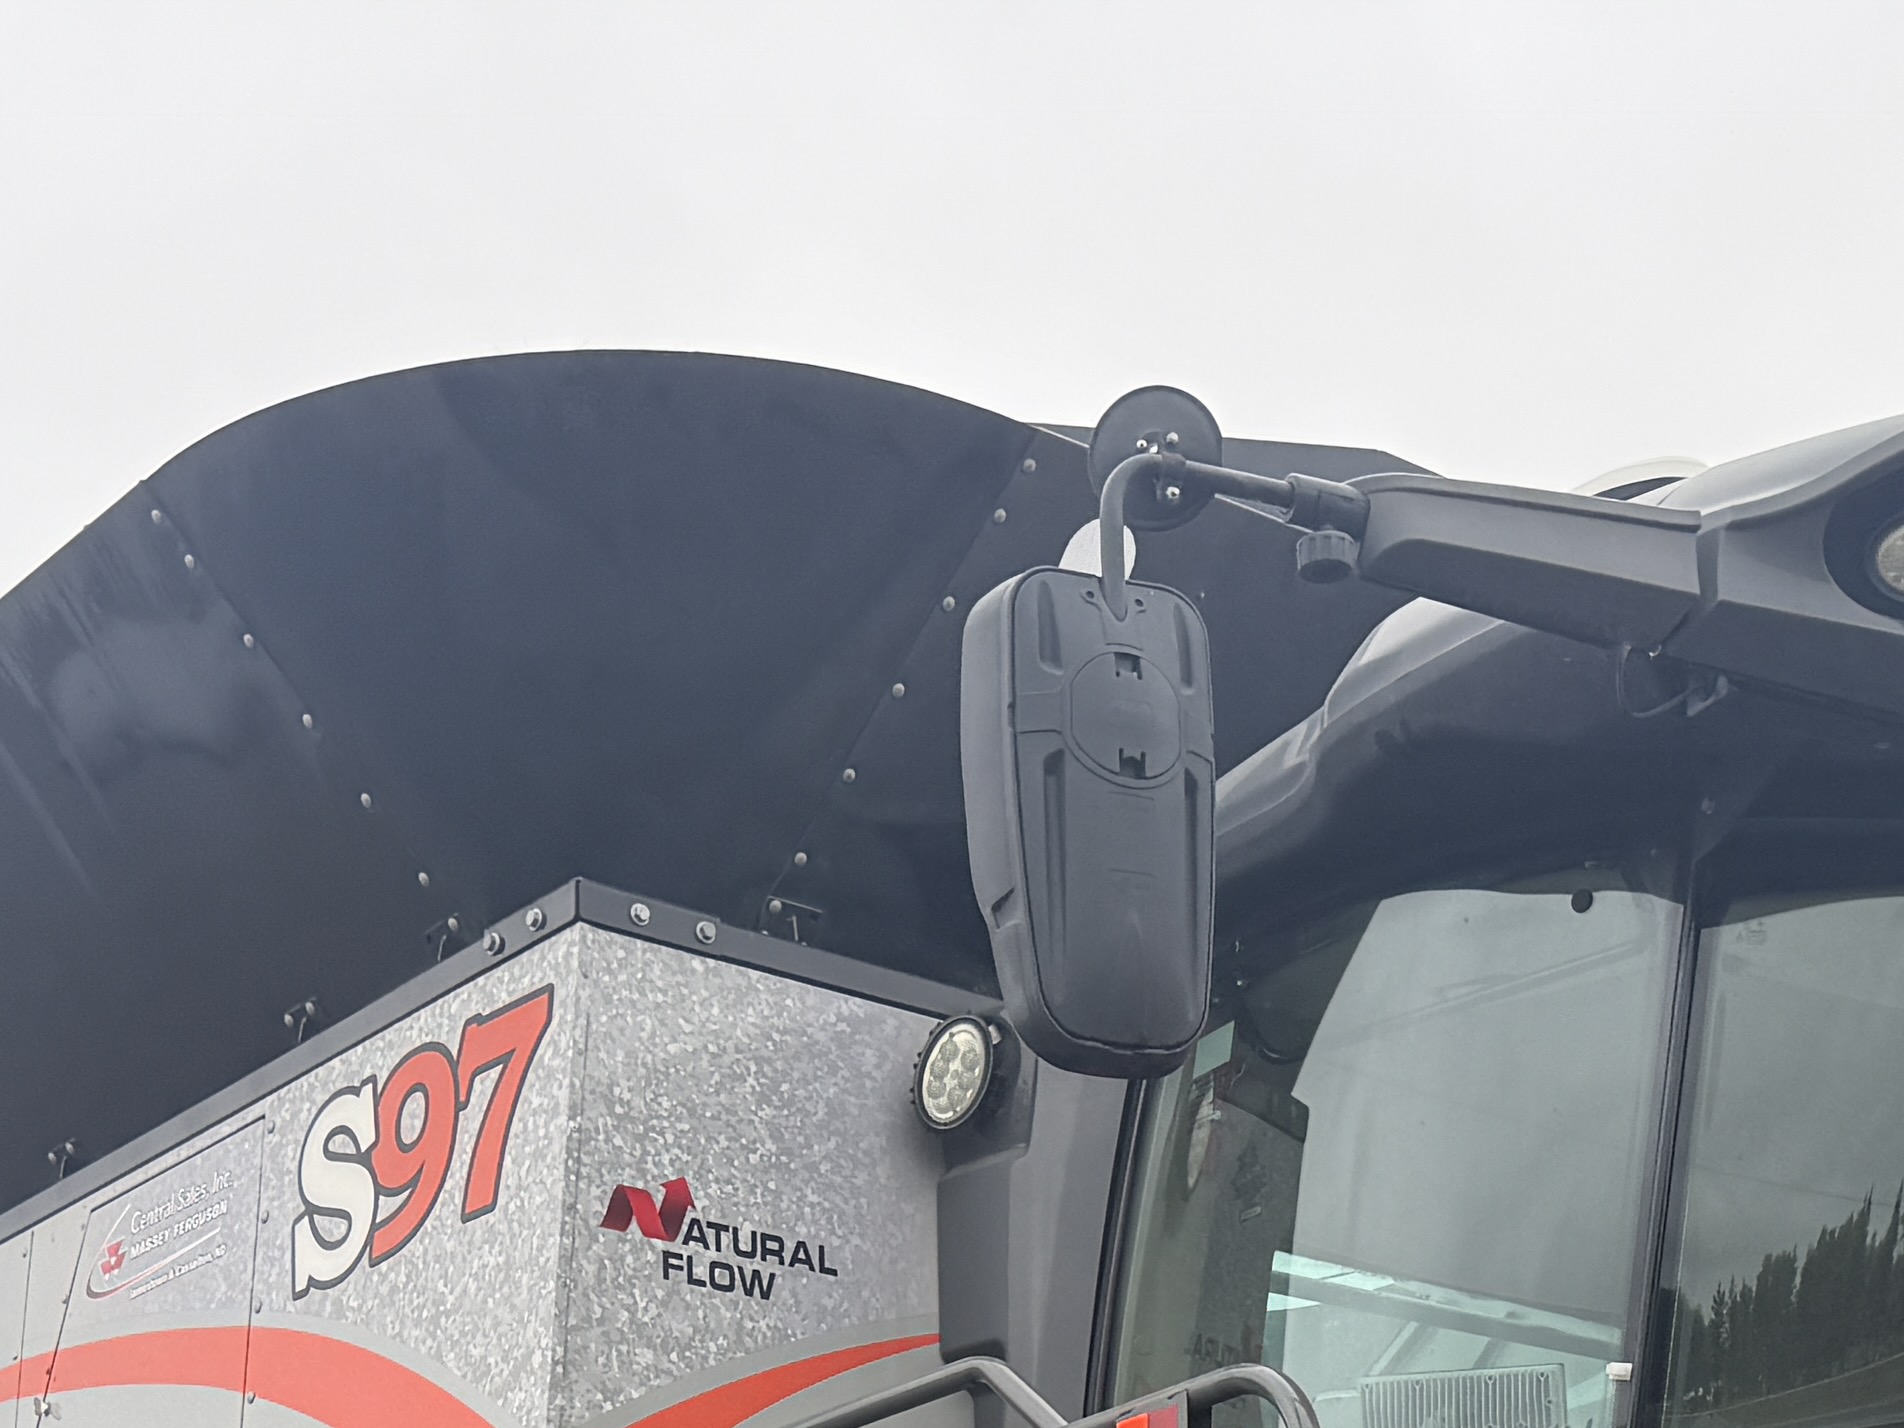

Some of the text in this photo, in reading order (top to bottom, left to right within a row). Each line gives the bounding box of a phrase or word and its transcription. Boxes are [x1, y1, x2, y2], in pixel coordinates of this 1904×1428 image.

[291, 983, 555, 1301] S97
[129, 1200, 229, 1260] MASSEY FERGUSON
[130, 1192, 176, 1234] Central
[600, 1176, 839, 1278] NATURAL
[661, 1248, 776, 1301] FLOW
